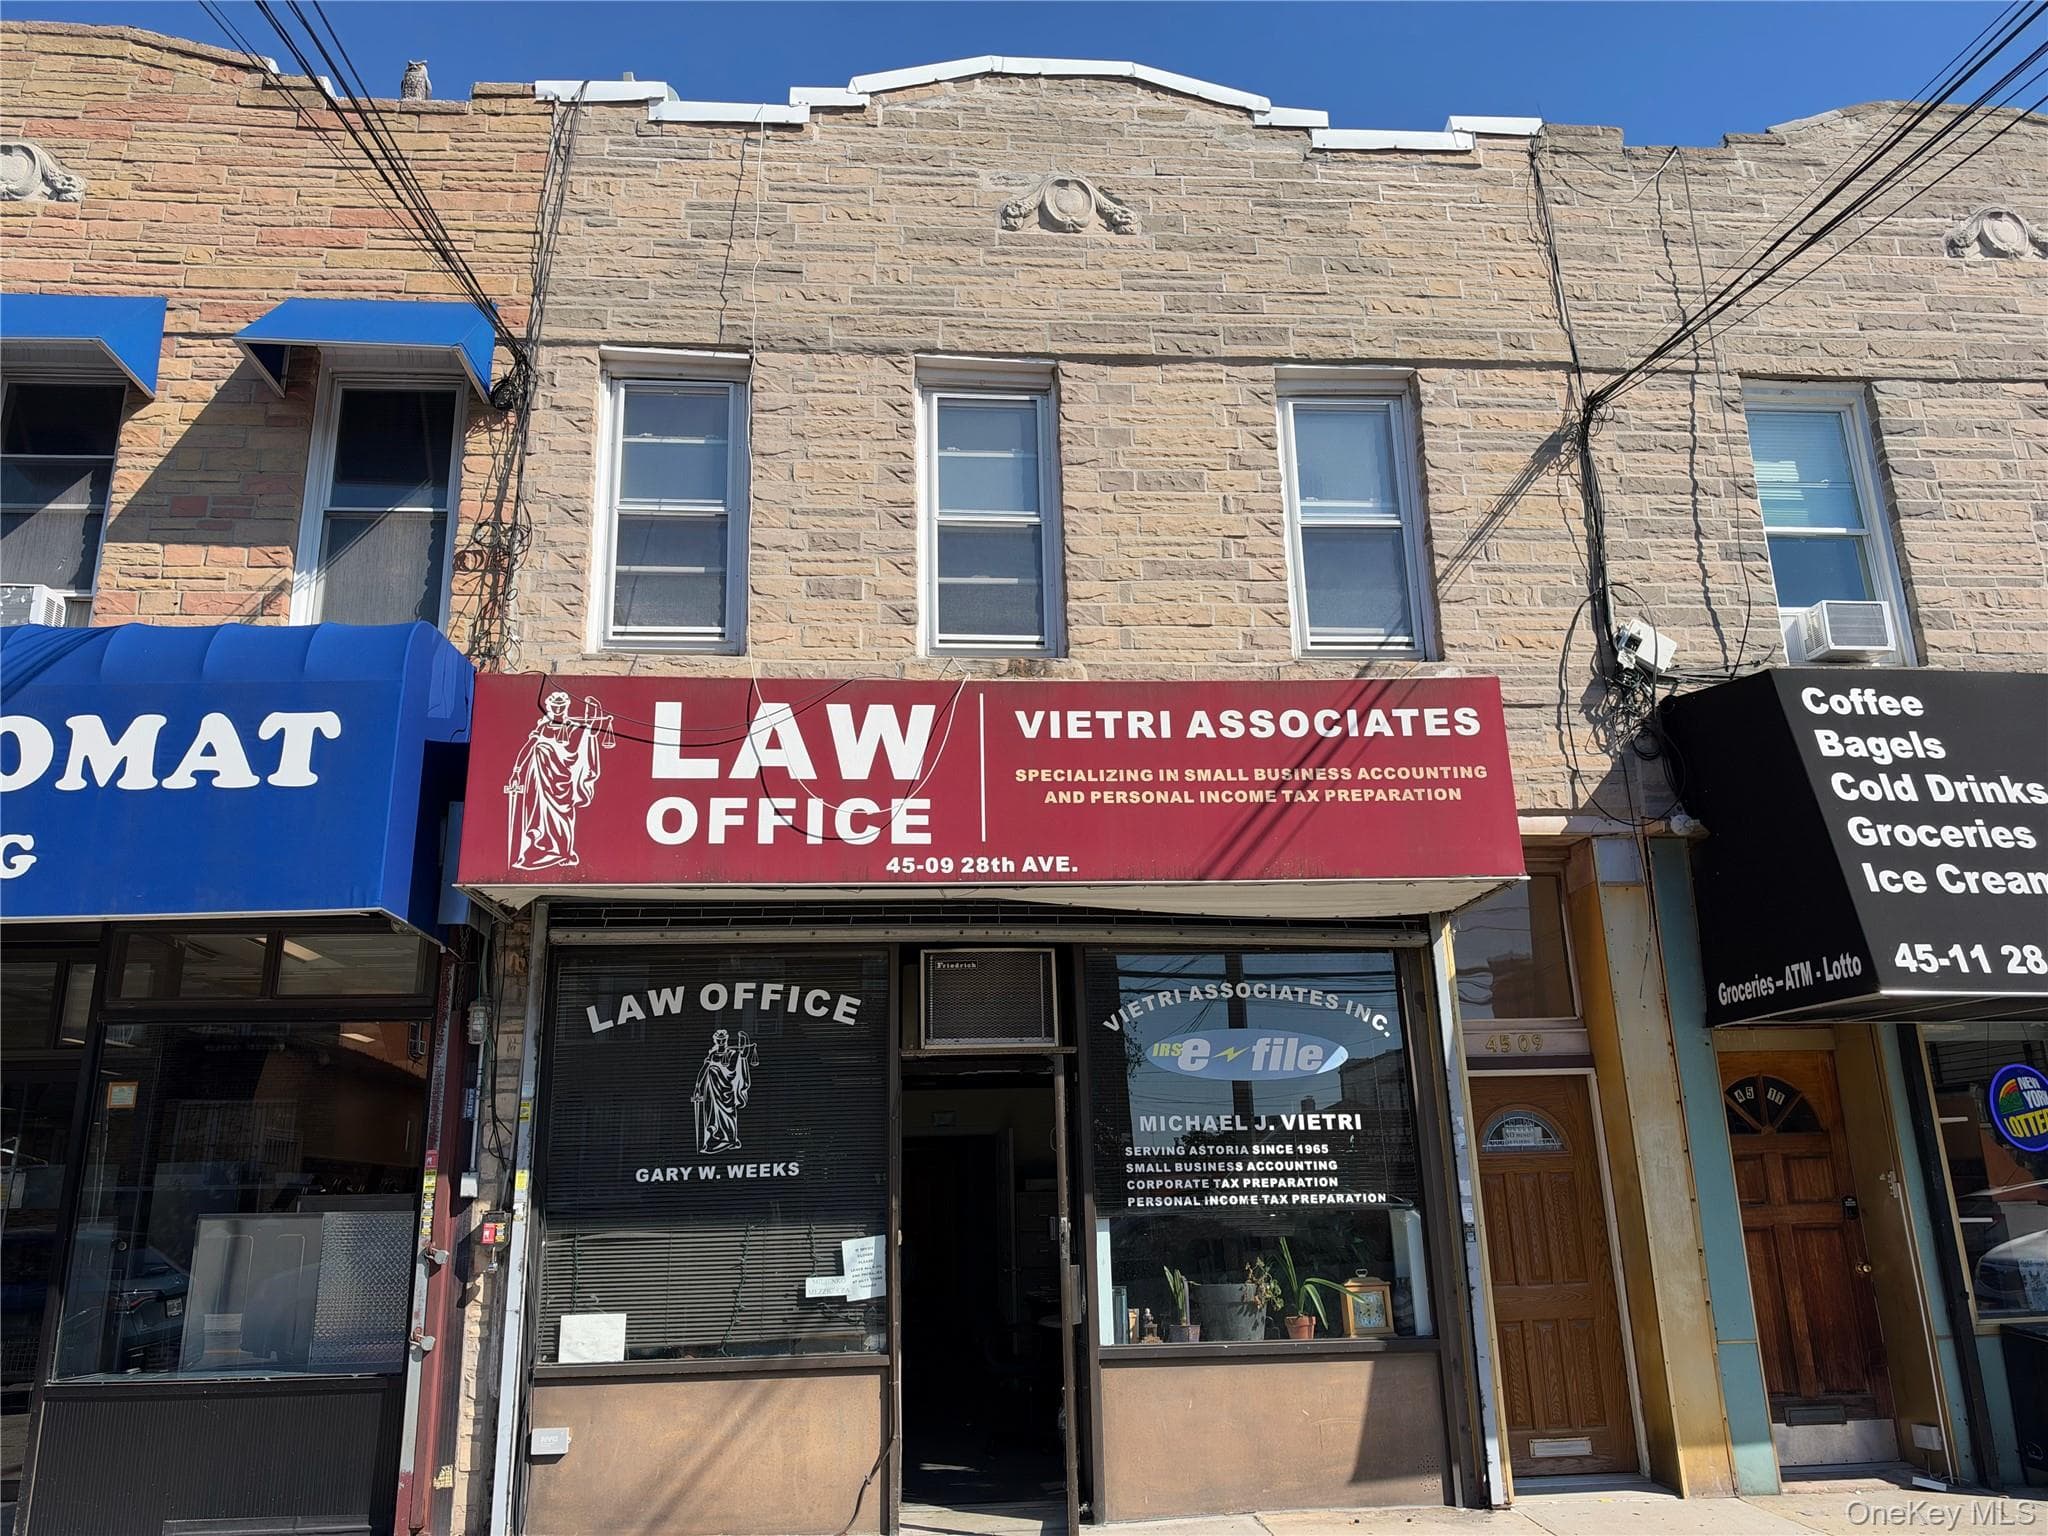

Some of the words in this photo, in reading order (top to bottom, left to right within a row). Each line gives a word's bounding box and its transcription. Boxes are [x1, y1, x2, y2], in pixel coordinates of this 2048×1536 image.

[1801, 687, 1924, 717] Coffee
[1015, 710, 1172, 739] VIETRI
[1185, 707, 1481, 739] ASSOCIATES
[0, 711, 342, 792] OMAT
[651, 701, 936, 780] LAW
[1814, 729, 1946, 765] Bagels
[1015, 769, 1153, 782] SPECIALIZING
[1159, 769, 1179, 782] IN
[1184, 769, 1249, 782] SMALL
[1254, 767, 1352, 781] BUSINESS
[1357, 766, 1488, 780] ACCOUNTING
[1830, 772, 1919, 802] Cold
[1924, 774, 2048, 805] Drinks
[1044, 791, 1085, 804] AND
[1090, 790, 1194, 804] PERSONAL
[1200, 790, 1277, 803] INCOME
[1282, 789, 1320, 803] TAX
[1325, 787, 1462, 802] PREPARATION
[645, 796, 933, 845] OFFICE
[1847, 816, 2037, 849] Groceries
[886, 857, 954, 873] 45-09
[960, 857, 1015, 873] 28th
[1021, 856, 1079, 873] AVE.
[1861, 863, 1928, 893] Ice
[1895, 943, 1992, 973] 45-11
[2000, 944, 2048, 975] 28
[1718, 973, 1775, 1006] Groceries
[1822, 952, 1862, 982] Lotto
[586, 985, 685, 1034] LAW
[700, 982, 862, 1026] OFFICE
[1103, 988, 1182, 1033] VIETRI
[1189, 982, 1339, 1010] ASSOCIATES
[1345, 1000, 1391, 1038] INC.
[1152, 1042, 1183, 1057] IRS
[1177, 1038, 1210, 1071] e
[1251, 1037, 1324, 1071] file
[2017, 1076, 2040, 1090] NEW
[1139, 1114, 1248, 1132] MICHAEL
[1254, 1114, 1275, 1131] J.
[1280, 1113, 1362, 1131] VIETRI
[1125, 1146, 1185, 1156] SERVING
[1189, 1145, 1249, 1156] ASTORIA
[1252, 1144, 1294, 1155] SINCE
[1296, 1144, 1329, 1154] 1965
[635, 1166, 692, 1183] GARY
[697, 1165, 721, 1181] W.
[727, 1162, 800, 1178] WEEKS
[1126, 1162, 1171, 1173] SMALL
[1175, 1162, 1243, 1172] BUSINESS
[1247, 1160, 1338, 1171] ACCOUNTING
[1127, 1179, 1210, 1190] CORPORATE
[1213, 1178, 1240, 1189] TAX
[1243, 1177, 1338, 1189] PREPARATION
[1128, 1196, 1201, 1207] PERSONAL
[1204, 1195, 1258, 1206] INCOME
[1261, 1194, 1288, 1205] TAX
[1292, 1193, 1387, 1205] PREPARATION
